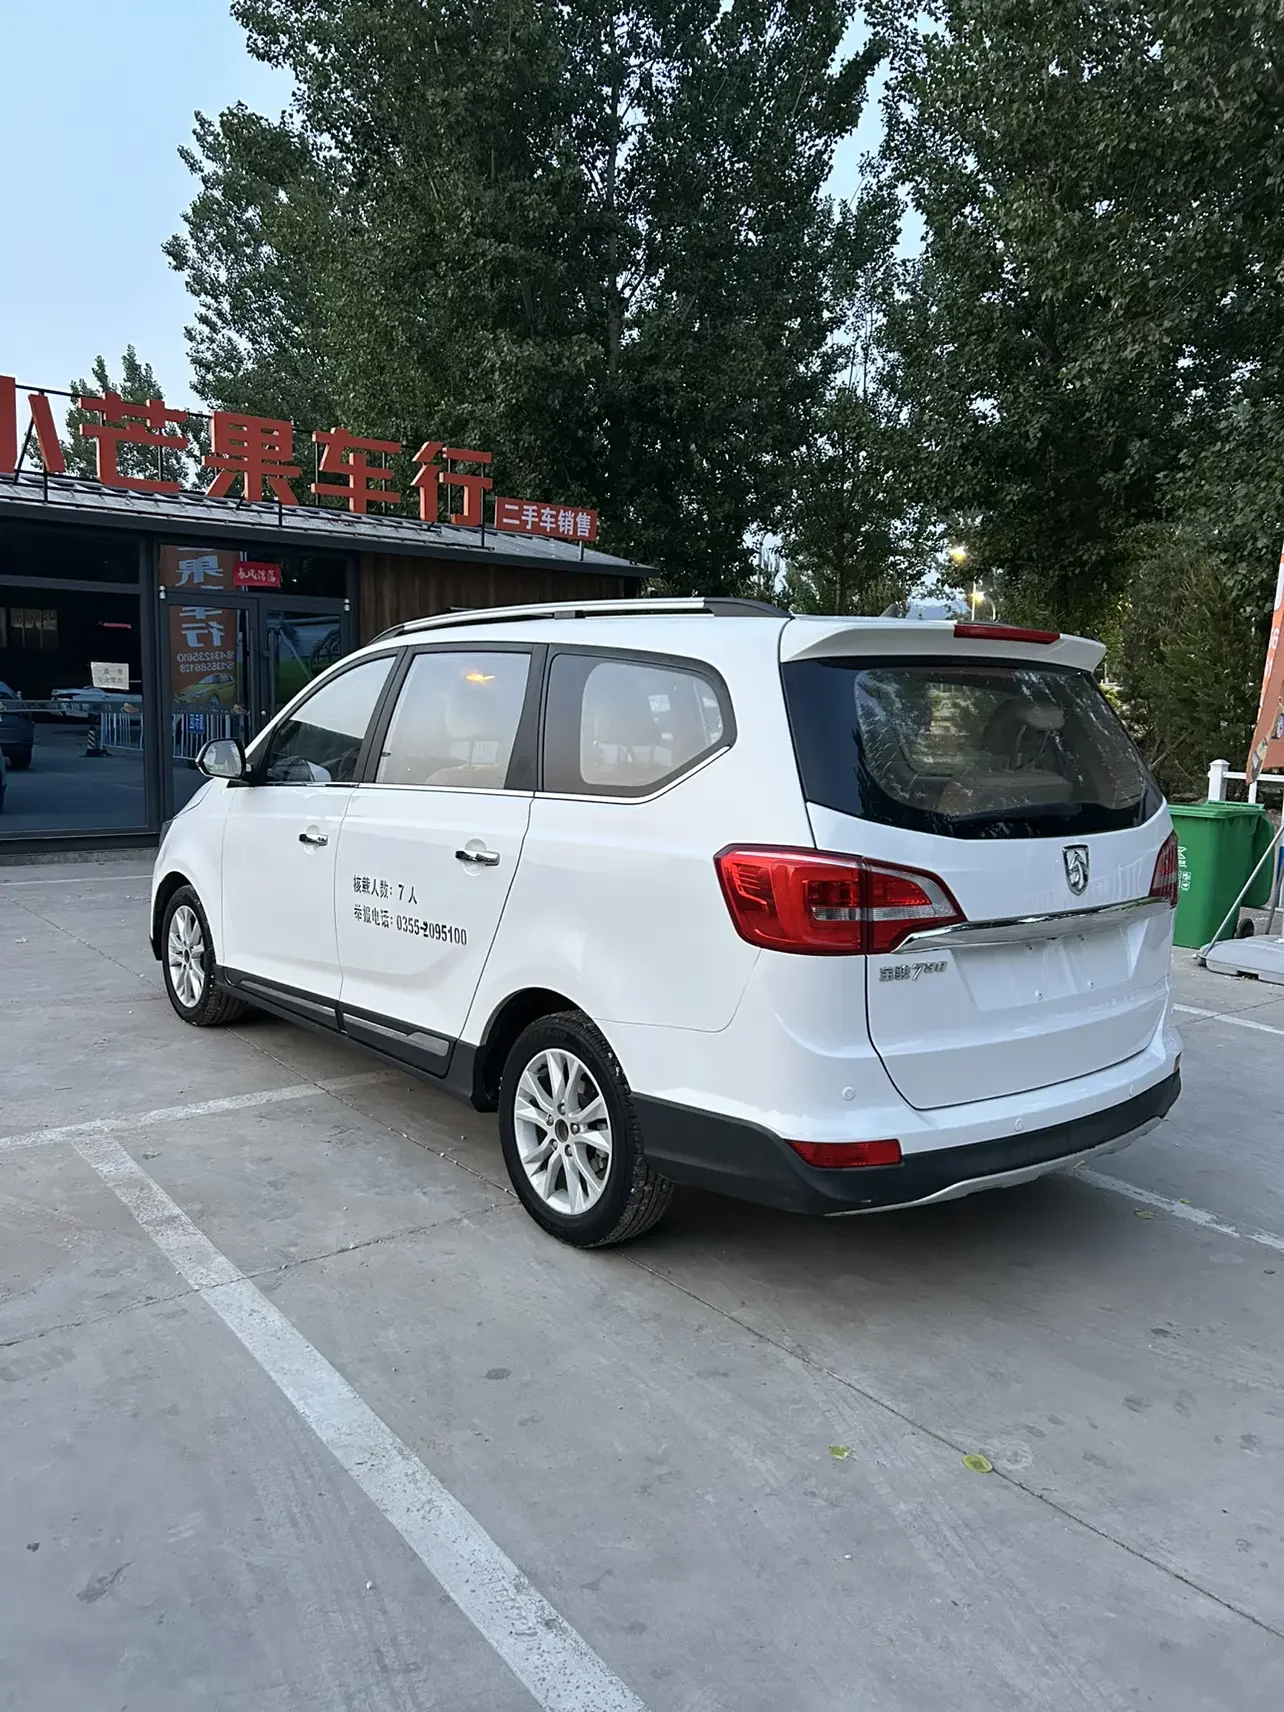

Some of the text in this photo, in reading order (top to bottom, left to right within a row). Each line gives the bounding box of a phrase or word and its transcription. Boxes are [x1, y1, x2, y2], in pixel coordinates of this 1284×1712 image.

[503, 504, 591, 537] 二手车销售
